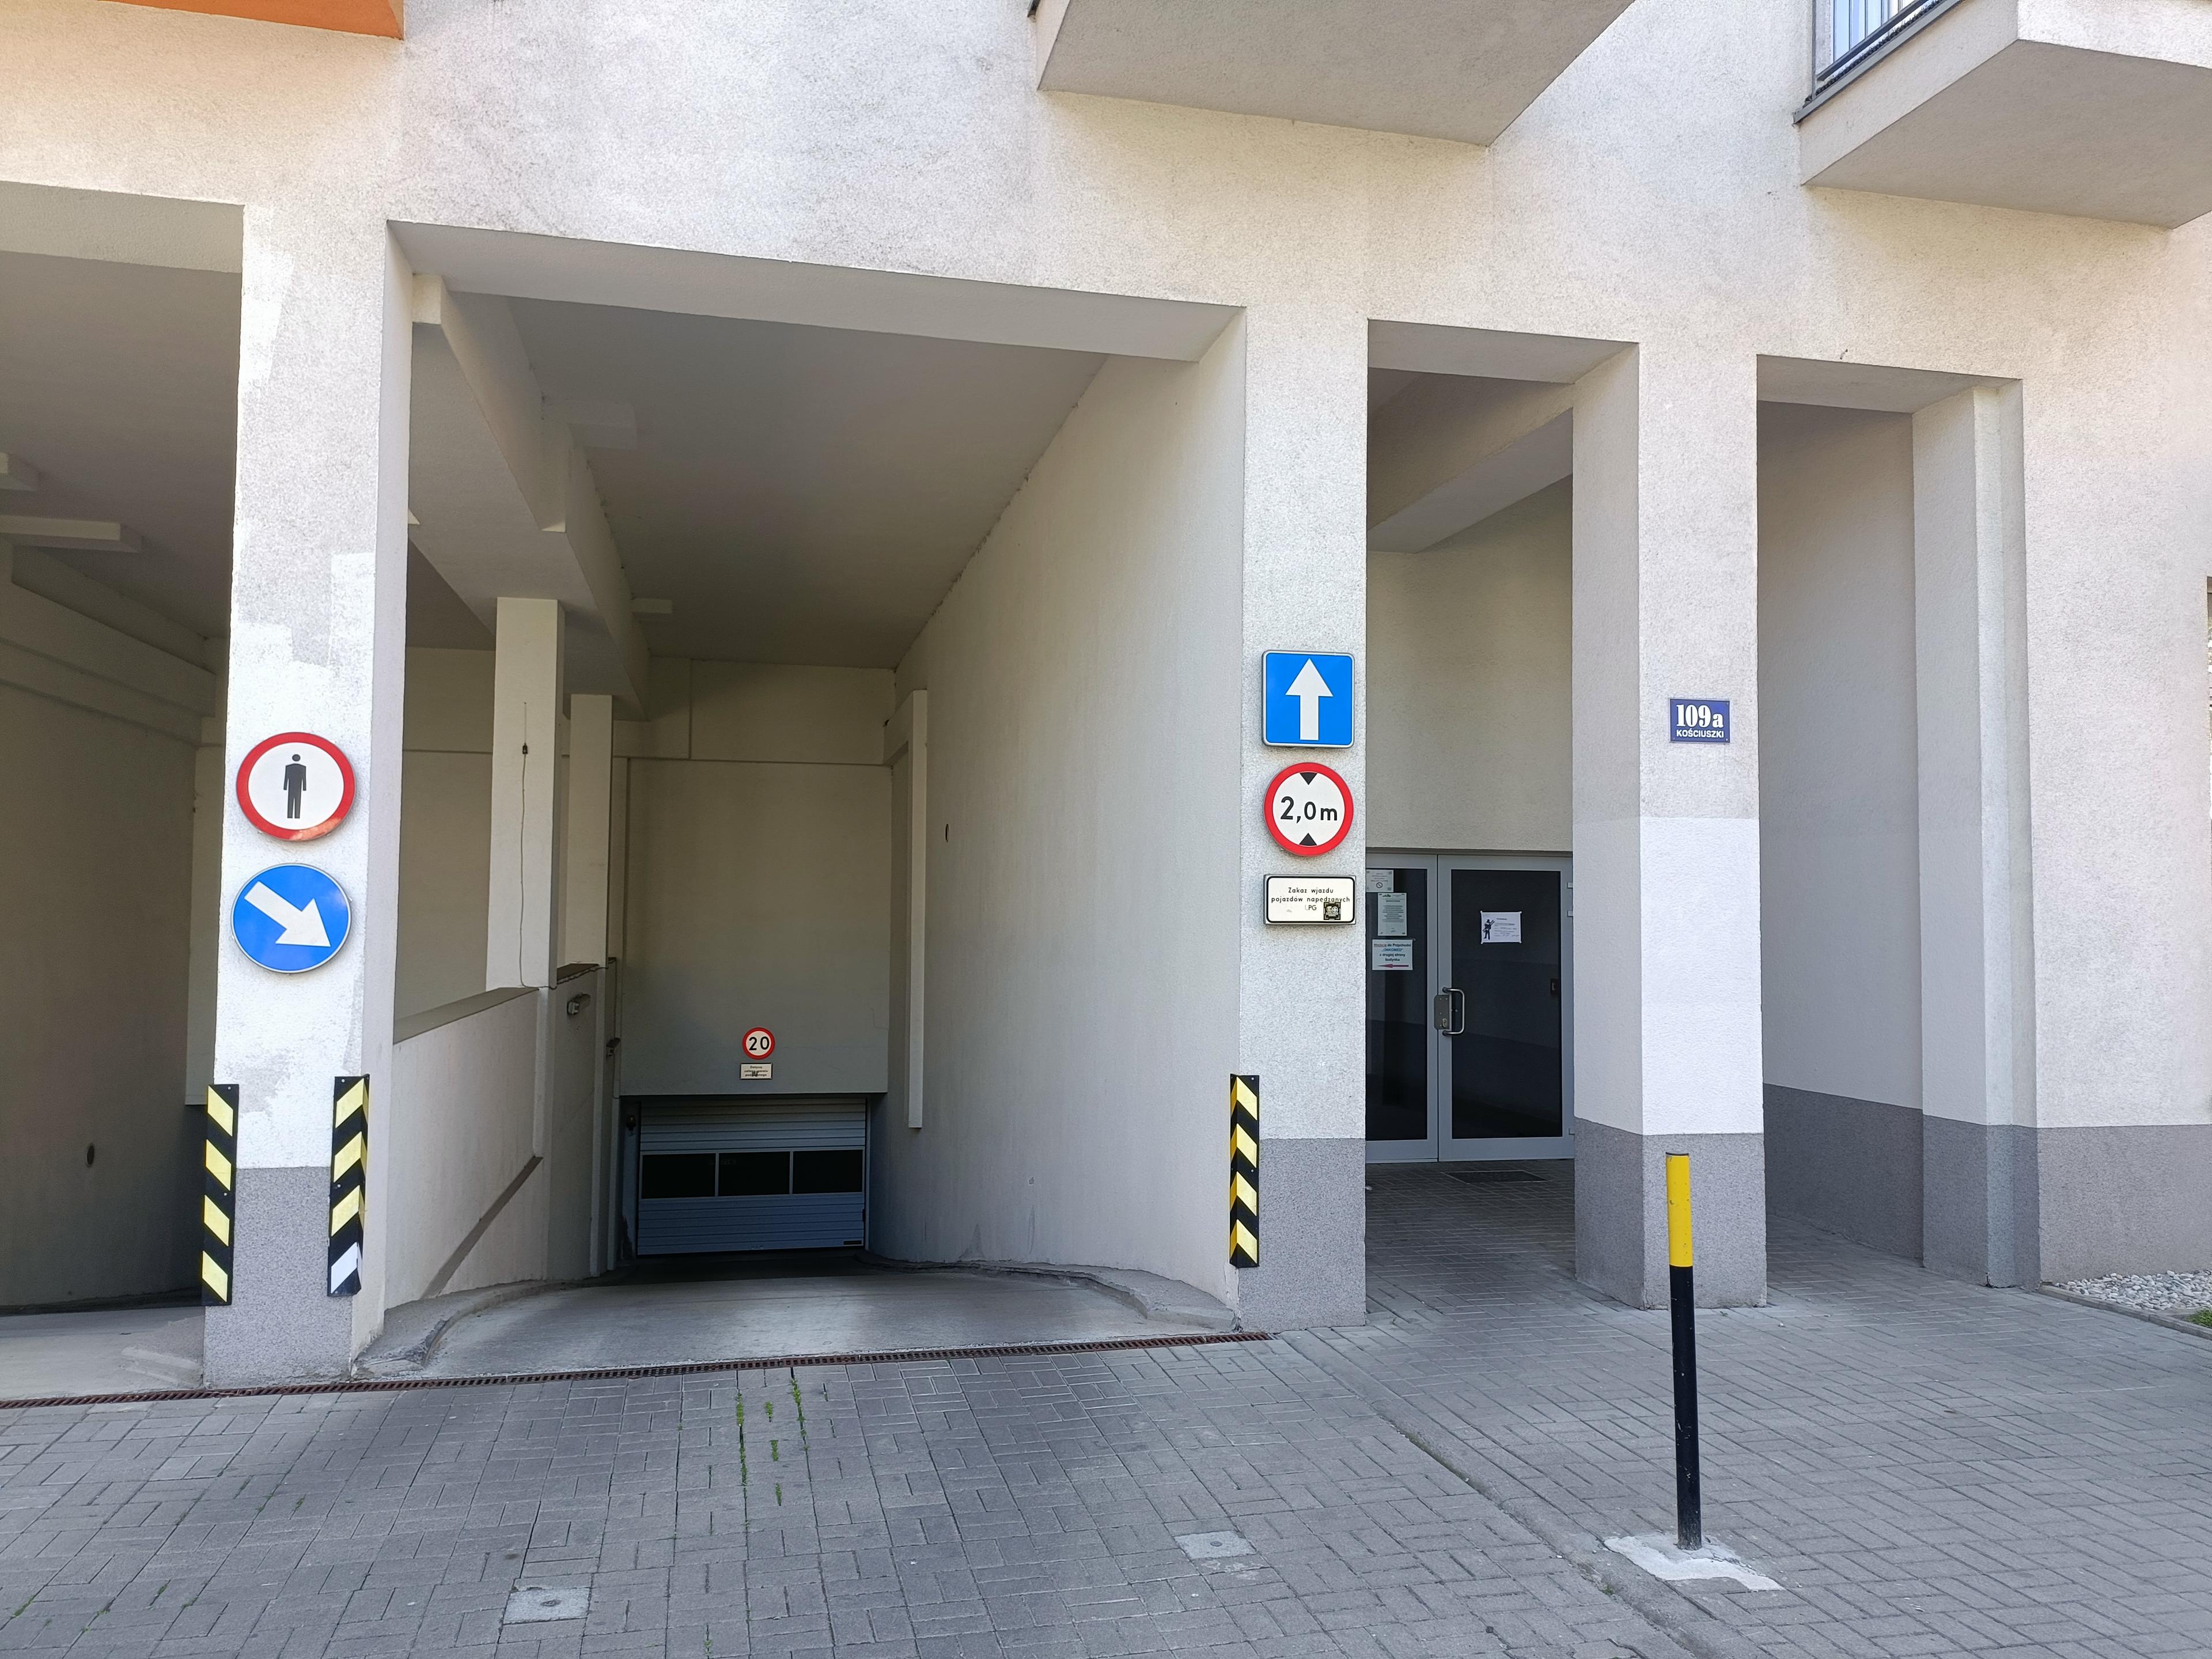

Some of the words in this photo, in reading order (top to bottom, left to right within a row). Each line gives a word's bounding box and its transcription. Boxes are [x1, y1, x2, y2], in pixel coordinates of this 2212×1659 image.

[1676, 704, 1724, 728] 109a
[1676, 728, 1724, 738] KOŚCIUSZKI
[749, 1036, 770, 1051] 20
